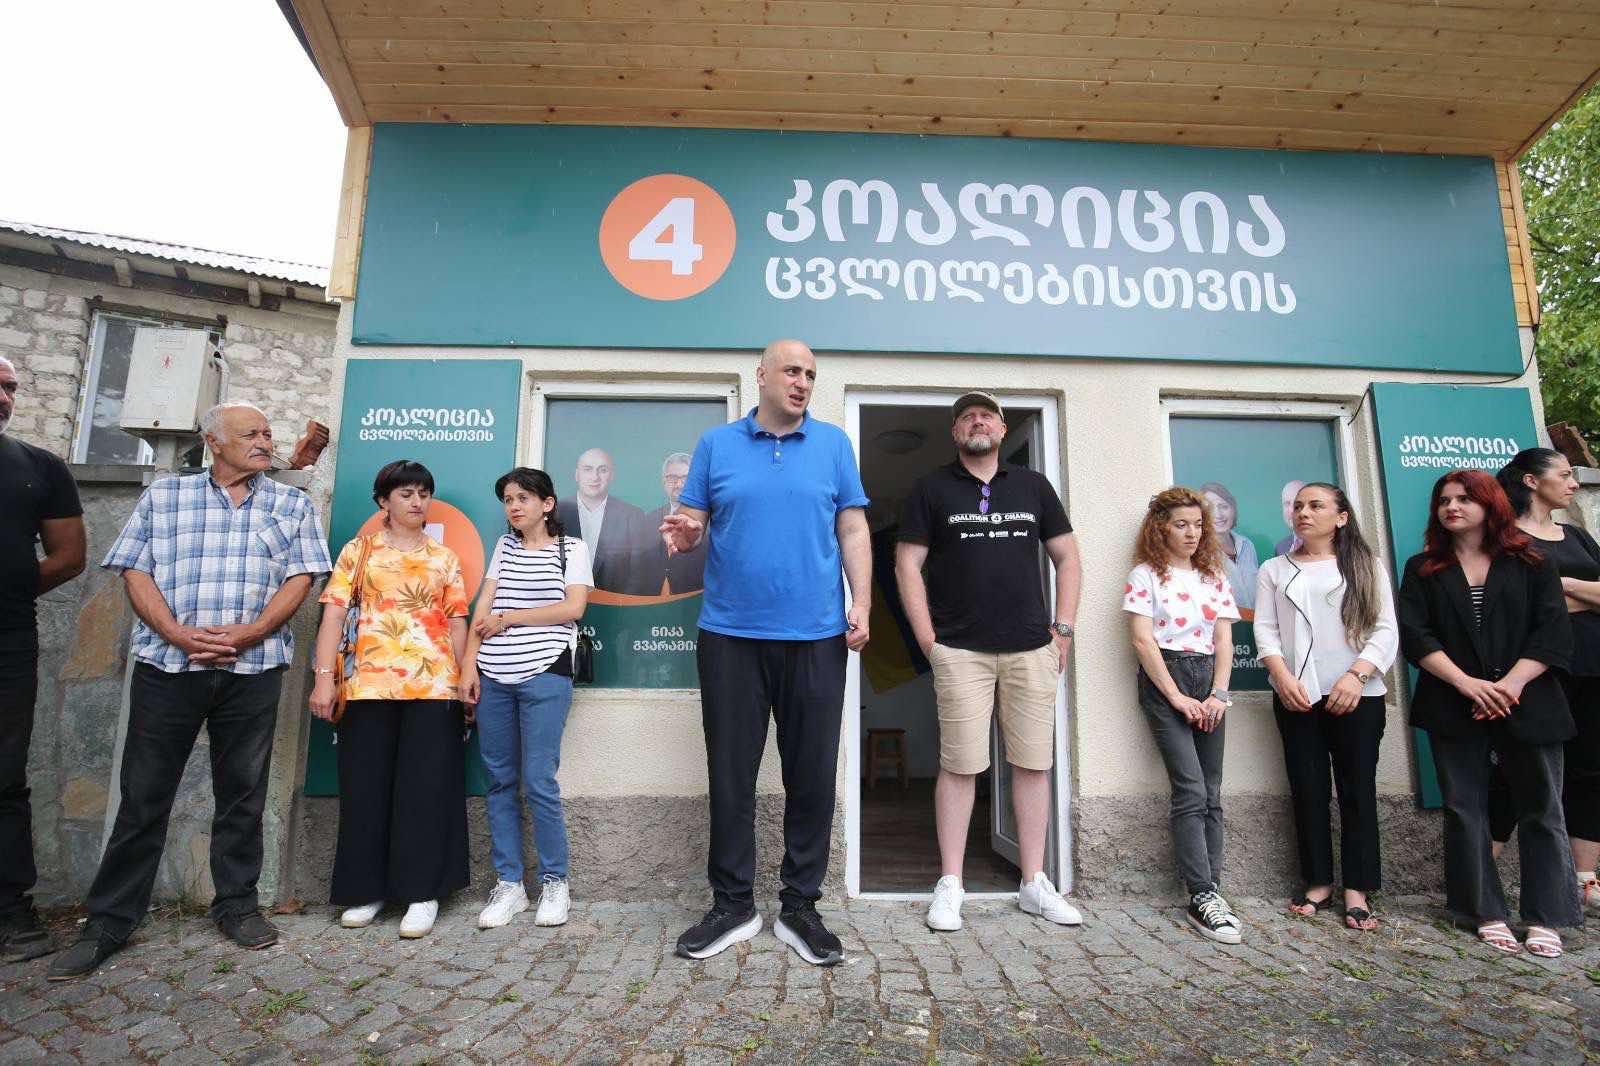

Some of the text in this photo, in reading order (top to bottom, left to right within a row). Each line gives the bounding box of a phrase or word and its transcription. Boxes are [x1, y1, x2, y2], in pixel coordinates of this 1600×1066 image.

[765, 179, 1286, 258] კოალიცია
[628, 197, 703, 275] 4
[765, 257, 1297, 315] ცვლილებისთვის
[361, 408, 495, 427] კოალიცია
[359, 428, 494, 442] ცვლილებისთვის
[1399, 435, 1520, 456] კოალიცია
[1401, 455, 1512, 469] ცვლილებისთვ
[949, 513, 989, 523] COALITION
[651, 626, 684, 637] ნიკა
[633, 640, 697, 651] გვარამი
